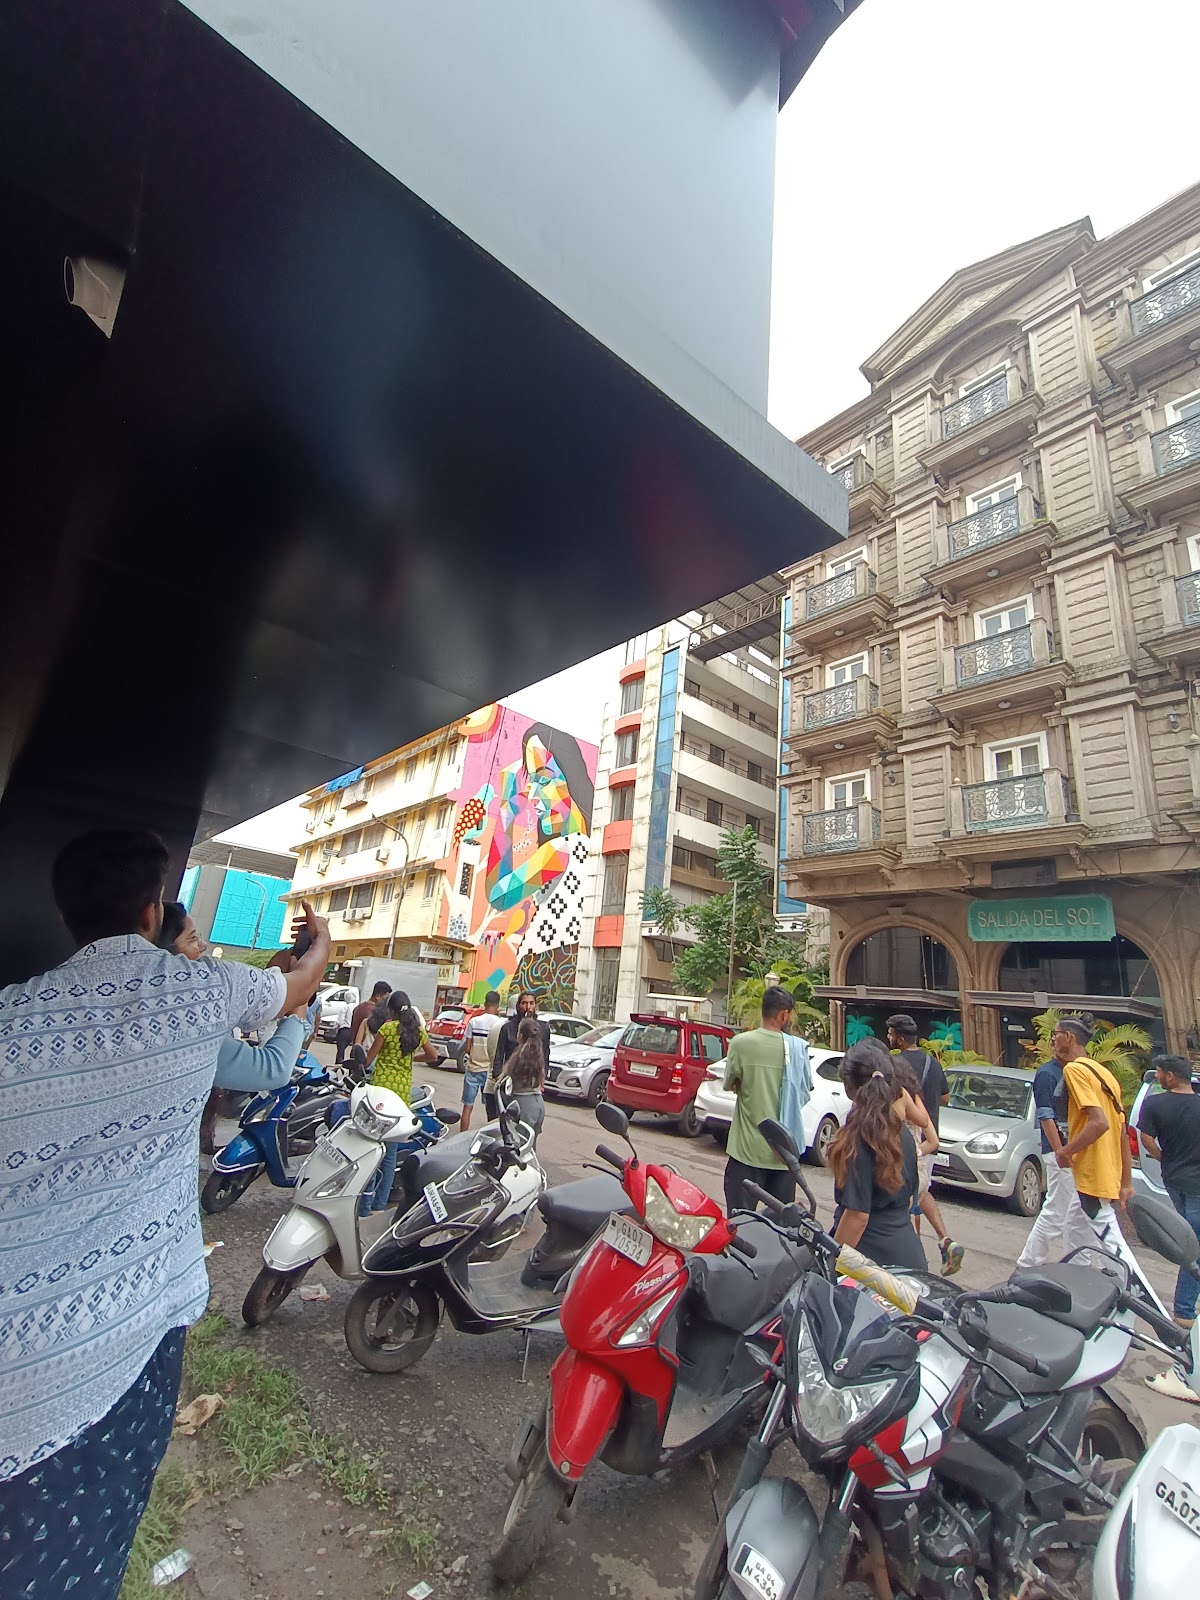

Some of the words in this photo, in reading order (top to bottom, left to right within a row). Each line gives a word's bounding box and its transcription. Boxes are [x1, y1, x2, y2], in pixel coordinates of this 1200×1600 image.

[977, 911, 1030, 928] SALIDA
[1033, 909, 1063, 927] DEL
[1067, 907, 1101, 926] SOL
[613, 1229, 644, 1261] Y0534
[621, 1222, 644, 1247] GA07
